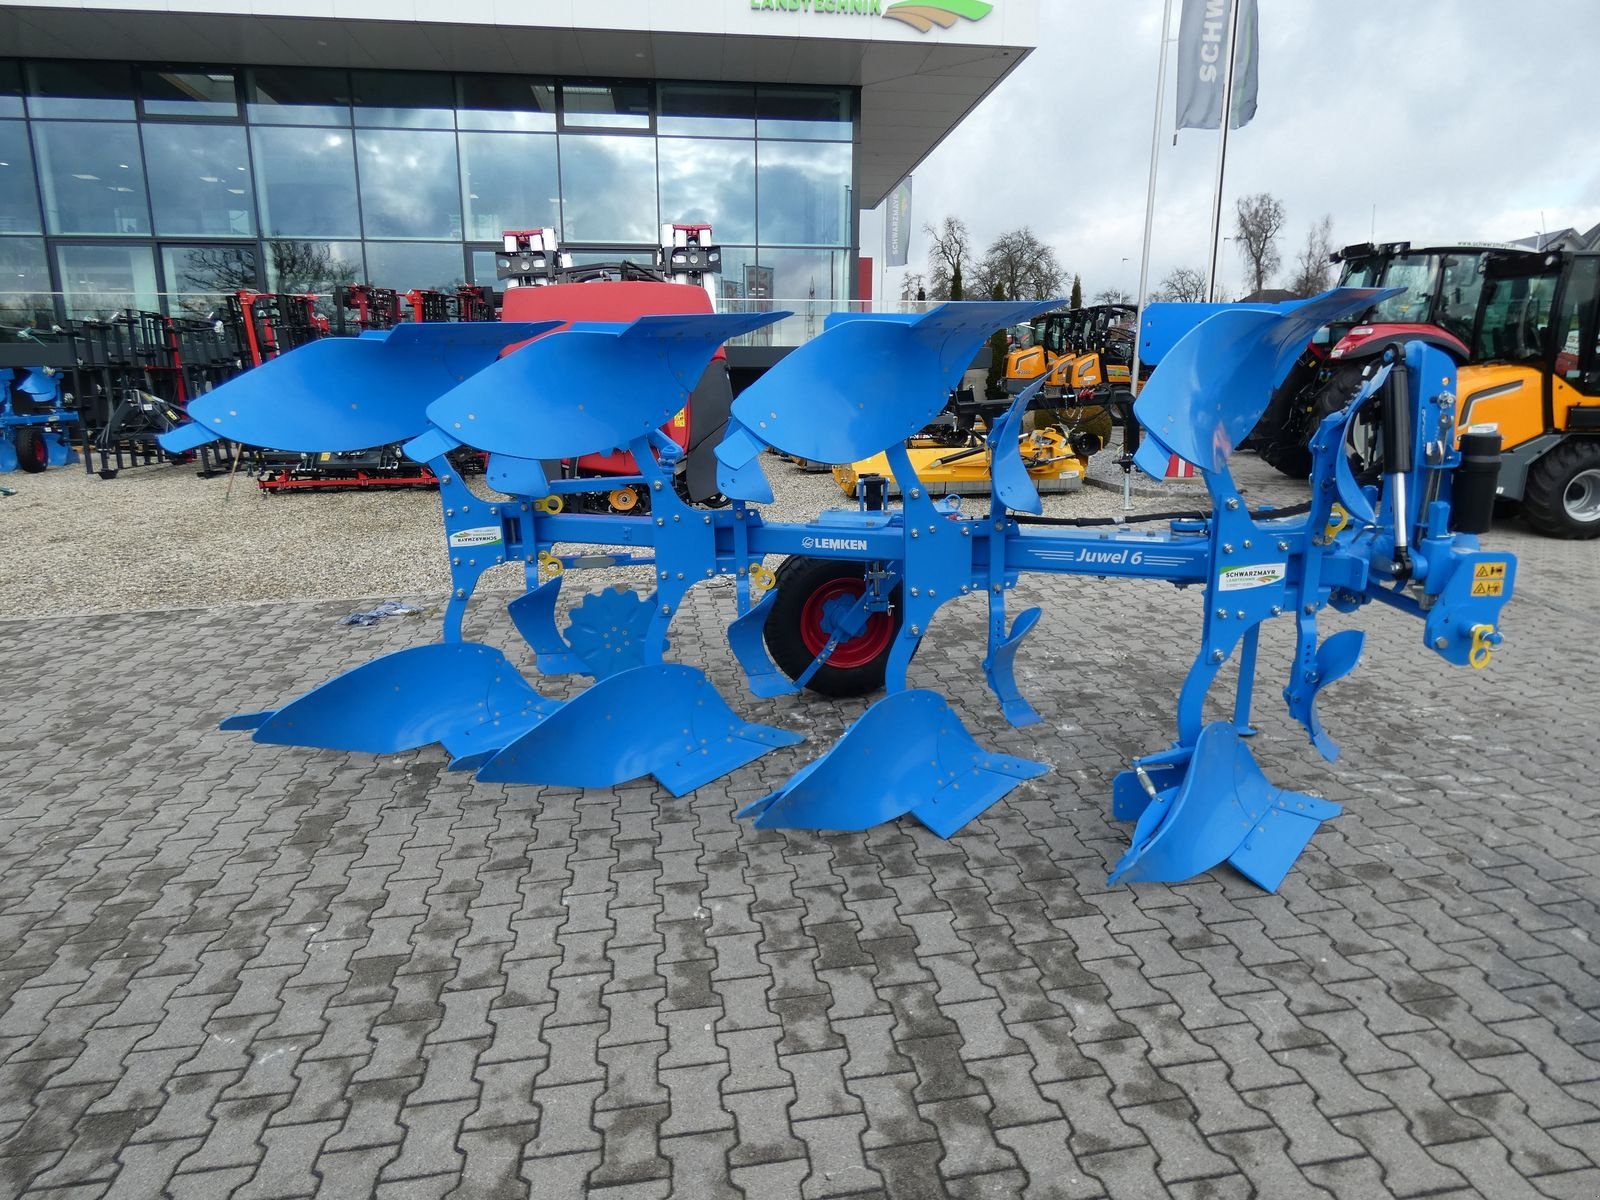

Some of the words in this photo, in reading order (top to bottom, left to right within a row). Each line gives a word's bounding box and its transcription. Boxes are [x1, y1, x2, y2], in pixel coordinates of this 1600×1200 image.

[815, 538, 867, 550] LEMKEN
[1076, 549, 1128, 564] Juwel
[1130, 551, 1143, 564] 6
[1225, 569, 1276, 578] SCHWARZMAYR
